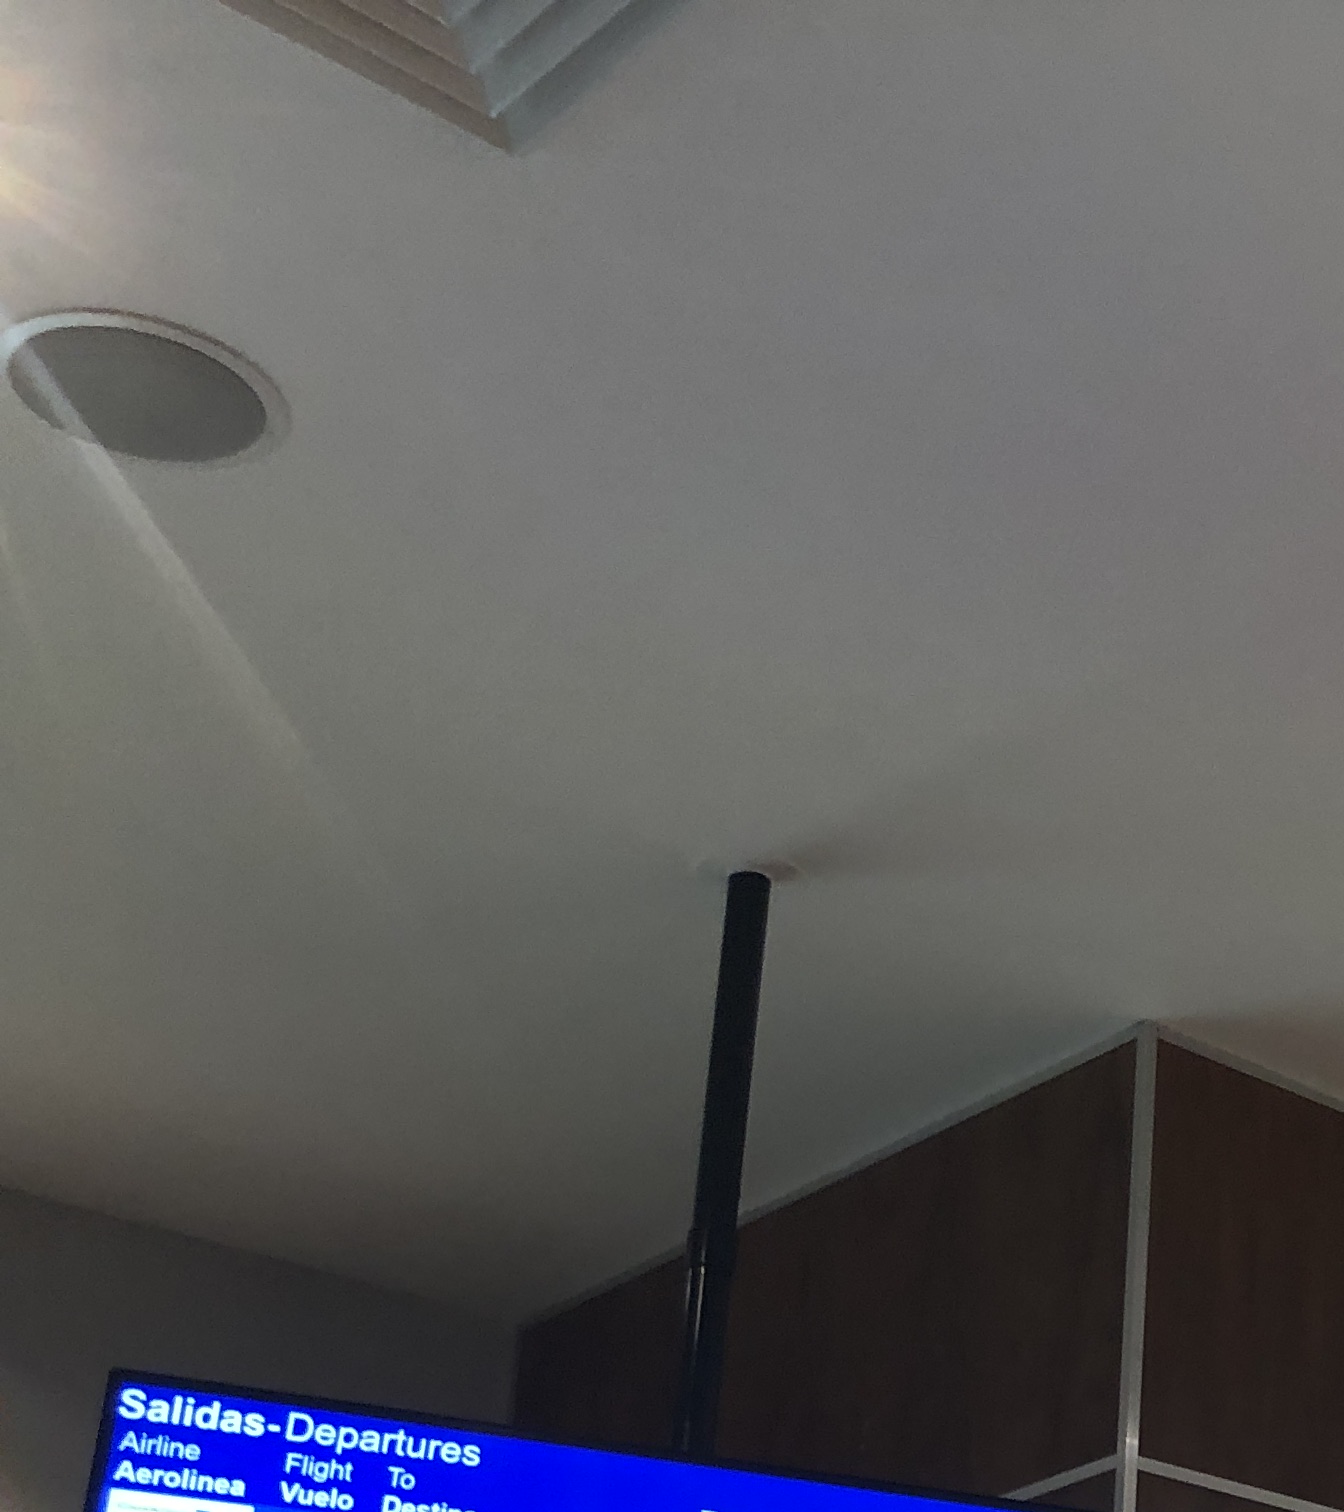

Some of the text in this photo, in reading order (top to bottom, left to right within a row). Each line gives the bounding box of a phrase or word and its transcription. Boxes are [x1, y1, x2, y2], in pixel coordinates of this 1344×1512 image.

[118, 1388, 481, 1466] Salidas-Departures
[113, 1460, 245, 1497] Aerolinea
[280, 1481, 354, 1510] Vuelo
[119, 1431, 201, 1461] Airline
[285, 1453, 353, 1483] Flight
[388, 1466, 416, 1490] To
